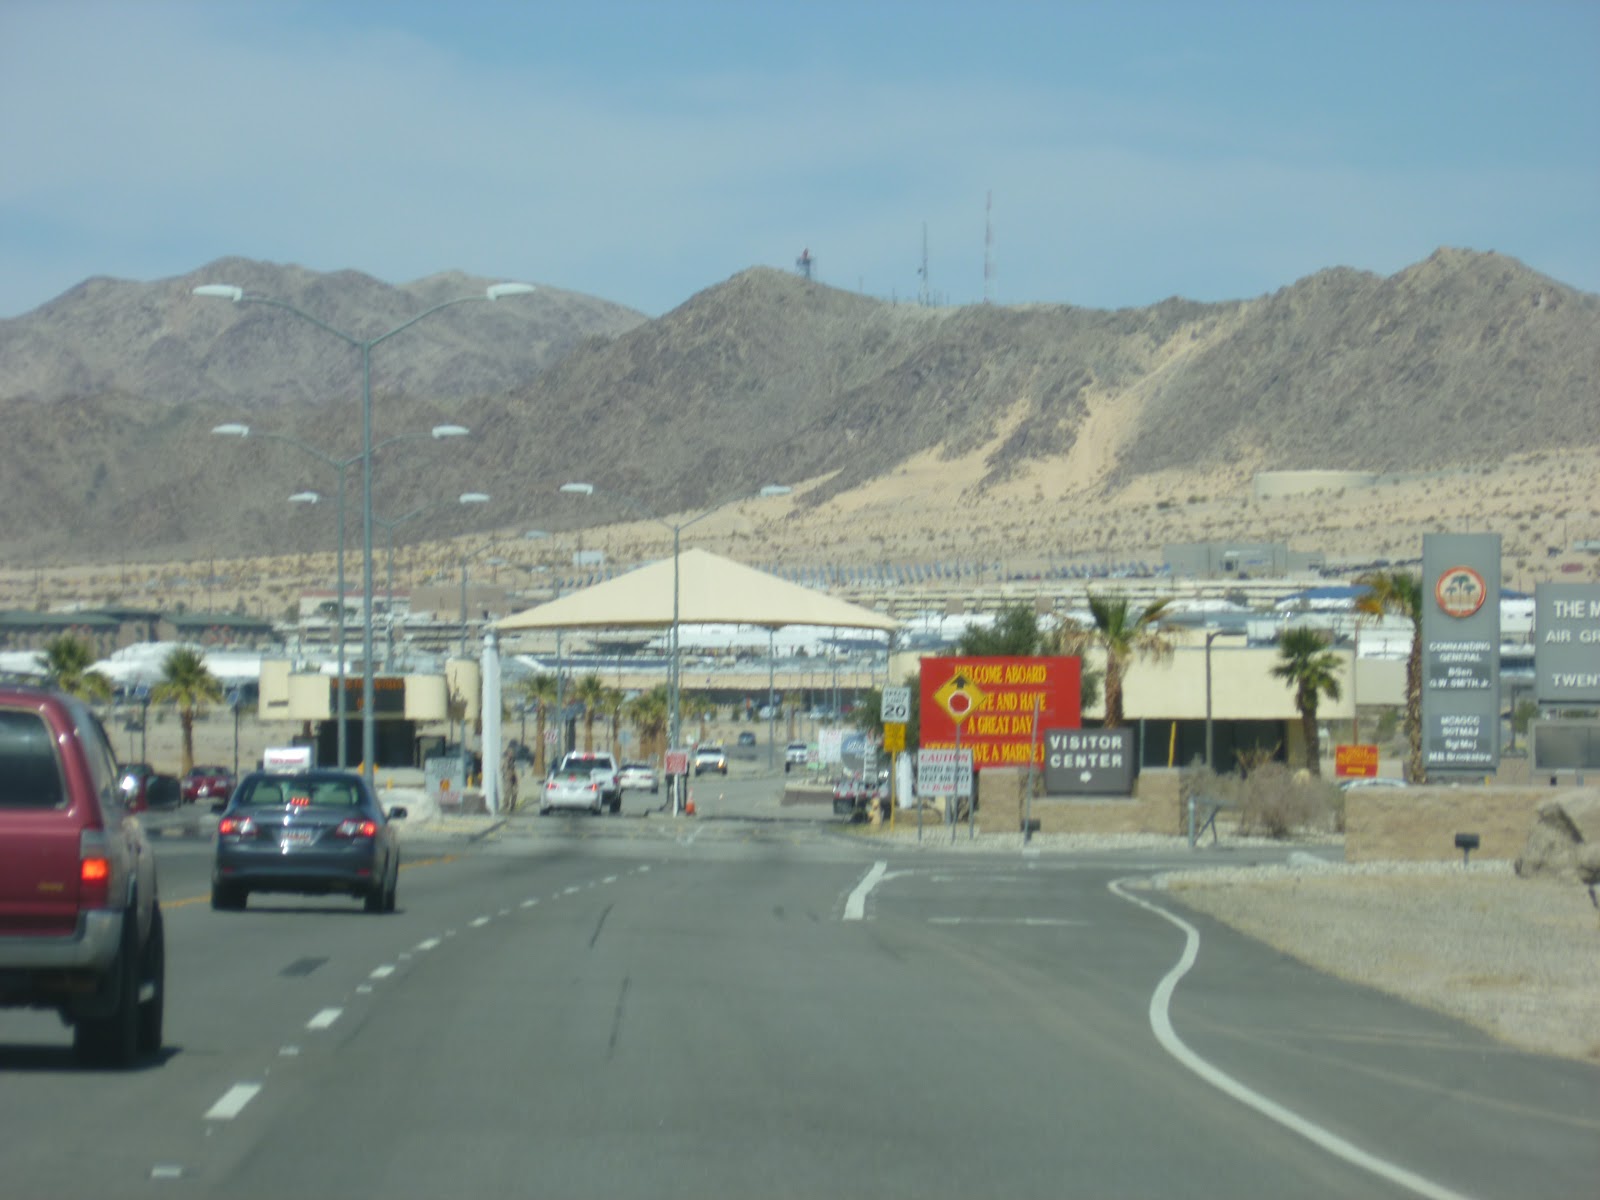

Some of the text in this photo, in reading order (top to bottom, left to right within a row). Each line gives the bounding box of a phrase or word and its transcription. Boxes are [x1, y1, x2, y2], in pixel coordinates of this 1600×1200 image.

[1553, 600, 1586, 619] THE
[1546, 630, 1571, 643] AIR
[1439, 652, 1482, 662] GENERAL
[1004, 664, 1047, 684] ABOARD
[1552, 674, 1600, 687] TWEN
[996, 692, 1018, 711] AND
[1020, 692, 1046, 711] HAVE
[884, 704, 906, 717] 20
[967, 715, 1033, 734] A GREAT DAY
[1050, 735, 1122, 750] VISITOR
[921, 753, 969, 762] CAUTION
[991, 743, 1000, 762] A
[1050, 753, 1122, 768] CENTER
